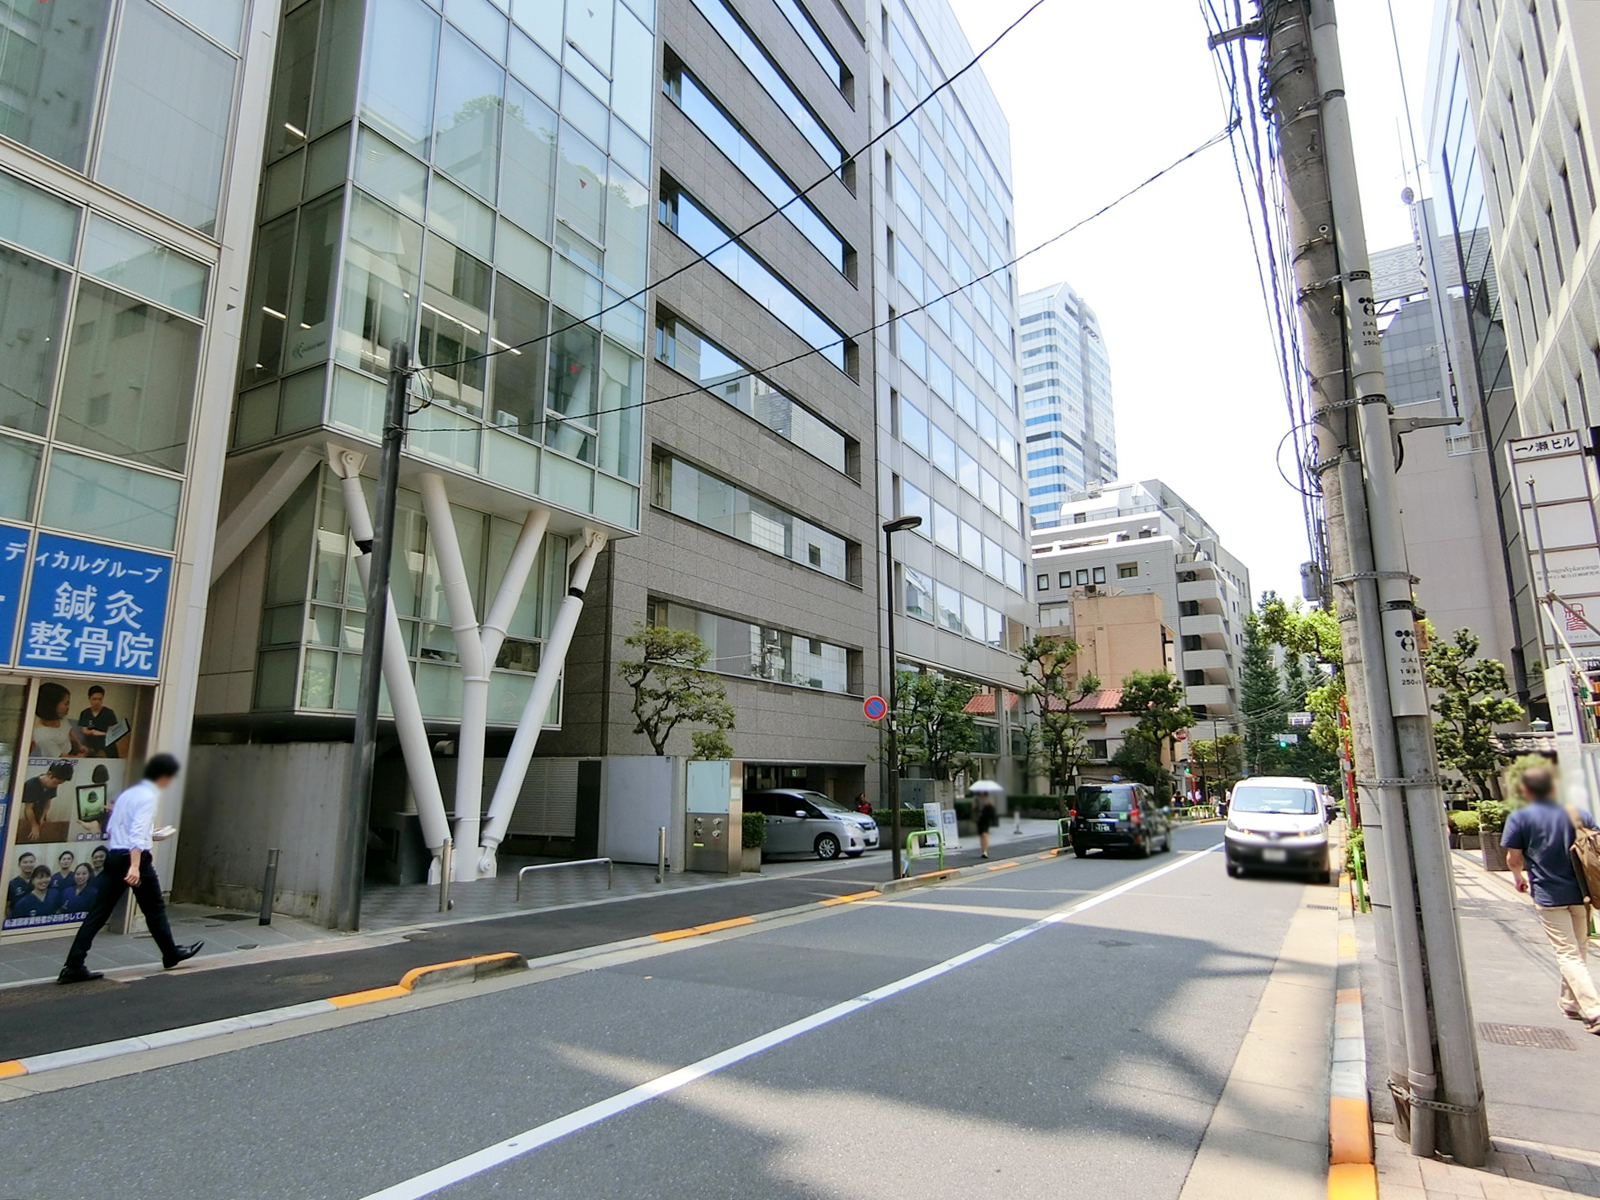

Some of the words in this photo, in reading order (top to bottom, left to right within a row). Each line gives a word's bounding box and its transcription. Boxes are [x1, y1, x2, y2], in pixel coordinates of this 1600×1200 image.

[1515, 436, 1575, 452] 一ノ瀬ビル
[53, 581, 144, 629] 鍼灸
[26, 620, 154, 670] 整骨院
